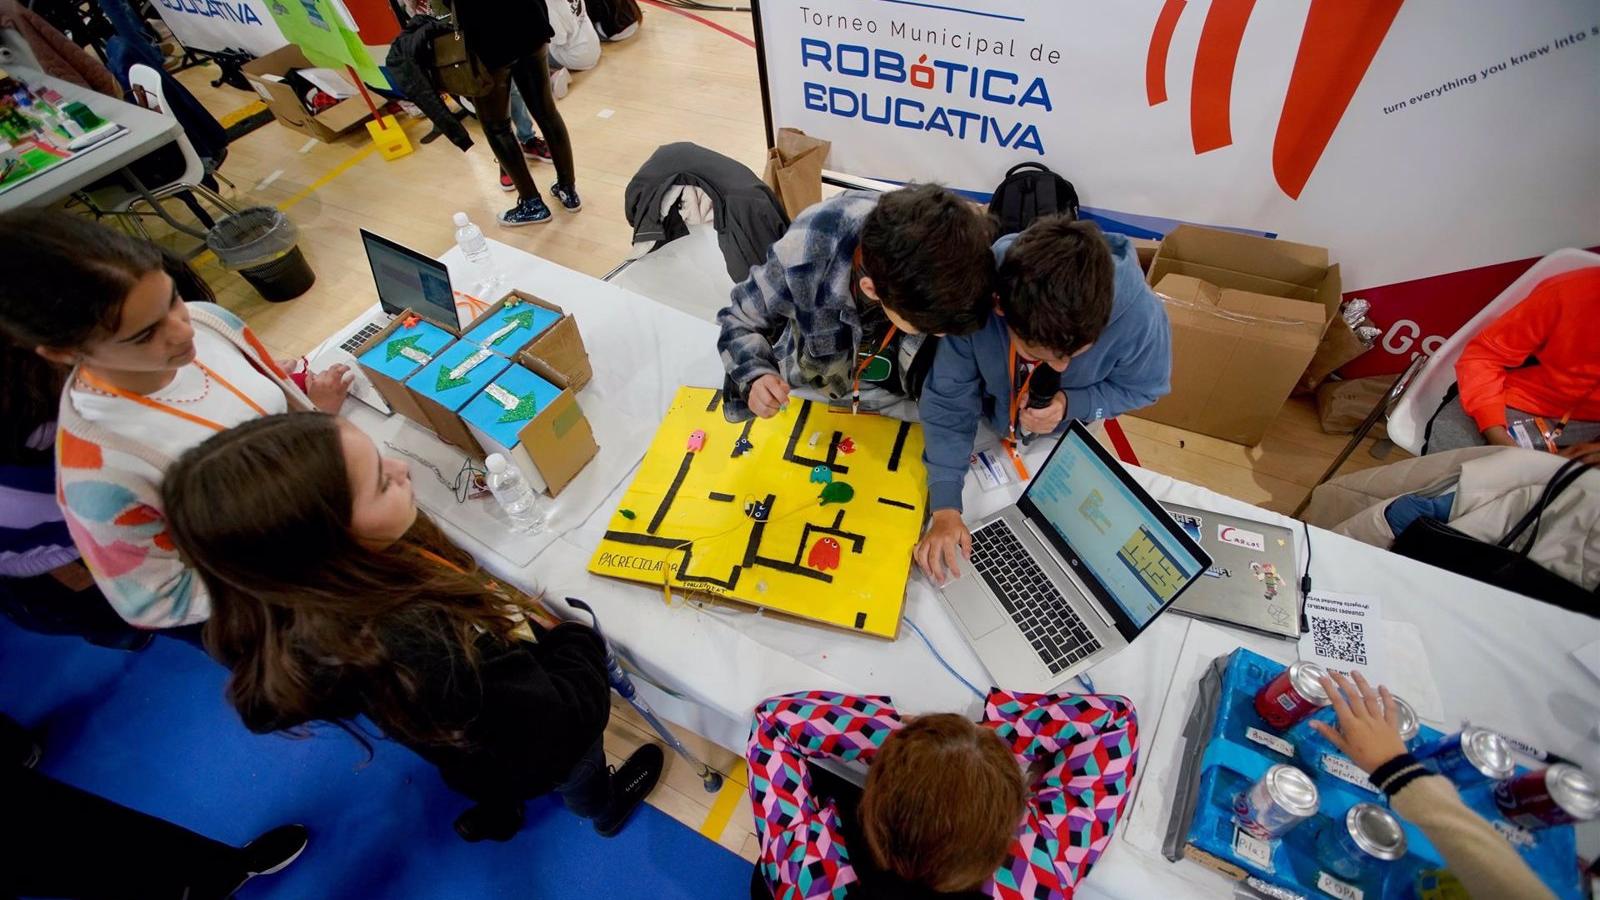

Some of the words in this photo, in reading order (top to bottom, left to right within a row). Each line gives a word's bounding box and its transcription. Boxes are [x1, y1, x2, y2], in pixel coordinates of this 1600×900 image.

[800, 7, 878, 34] Torneo
[891, 20, 1015, 58] Municipal
[1030, 43, 1062, 65] de
[1383, 98, 1407, 115] turn
[1409, 73, 1477, 105] everything
[1480, 61, 1507, 79] you
[1510, 43, 1550, 67] knew
[1554, 31, 1587, 50] into
[803, 81, 1046, 156] EDUCATIVA
